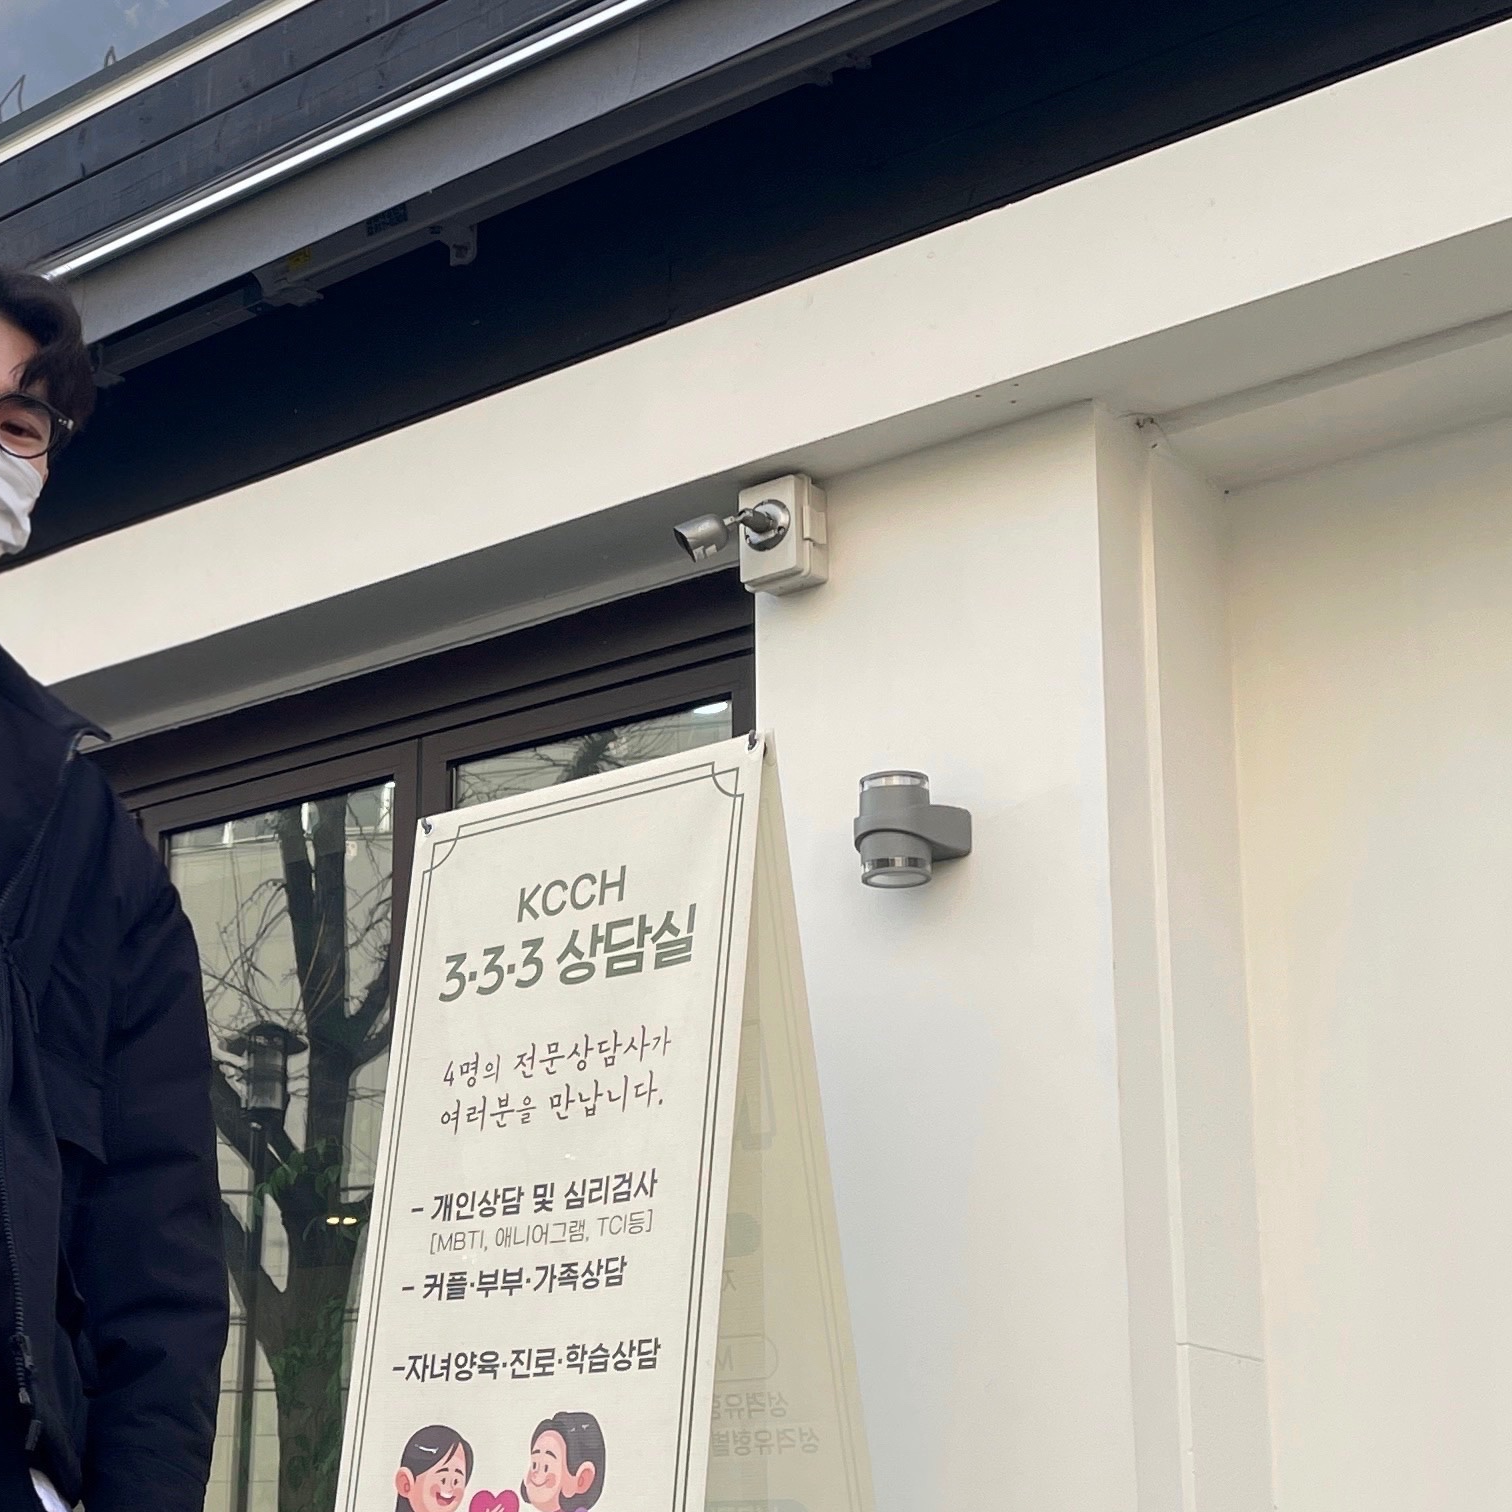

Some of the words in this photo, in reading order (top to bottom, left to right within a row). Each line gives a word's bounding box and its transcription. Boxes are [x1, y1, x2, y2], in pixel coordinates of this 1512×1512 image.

[517, 865, 627, 923] KCCH
[556, 902, 697, 986] 상담실
[443, 1051, 501, 1088] 4명의
[513, 1024, 673, 1079] 전문상담사가
[440, 1092, 538, 1135] 여러분을
[548, 1069, 665, 1121] 만납니다.
[430, 1185, 525, 1222] 개인상담
[532, 1182, 555, 1214] 및
[563, 1167, 658, 1210] 심리검사
[494, 1219, 590, 1248] 애니어그램,
[596, 1209, 654, 1237] TCI등]
